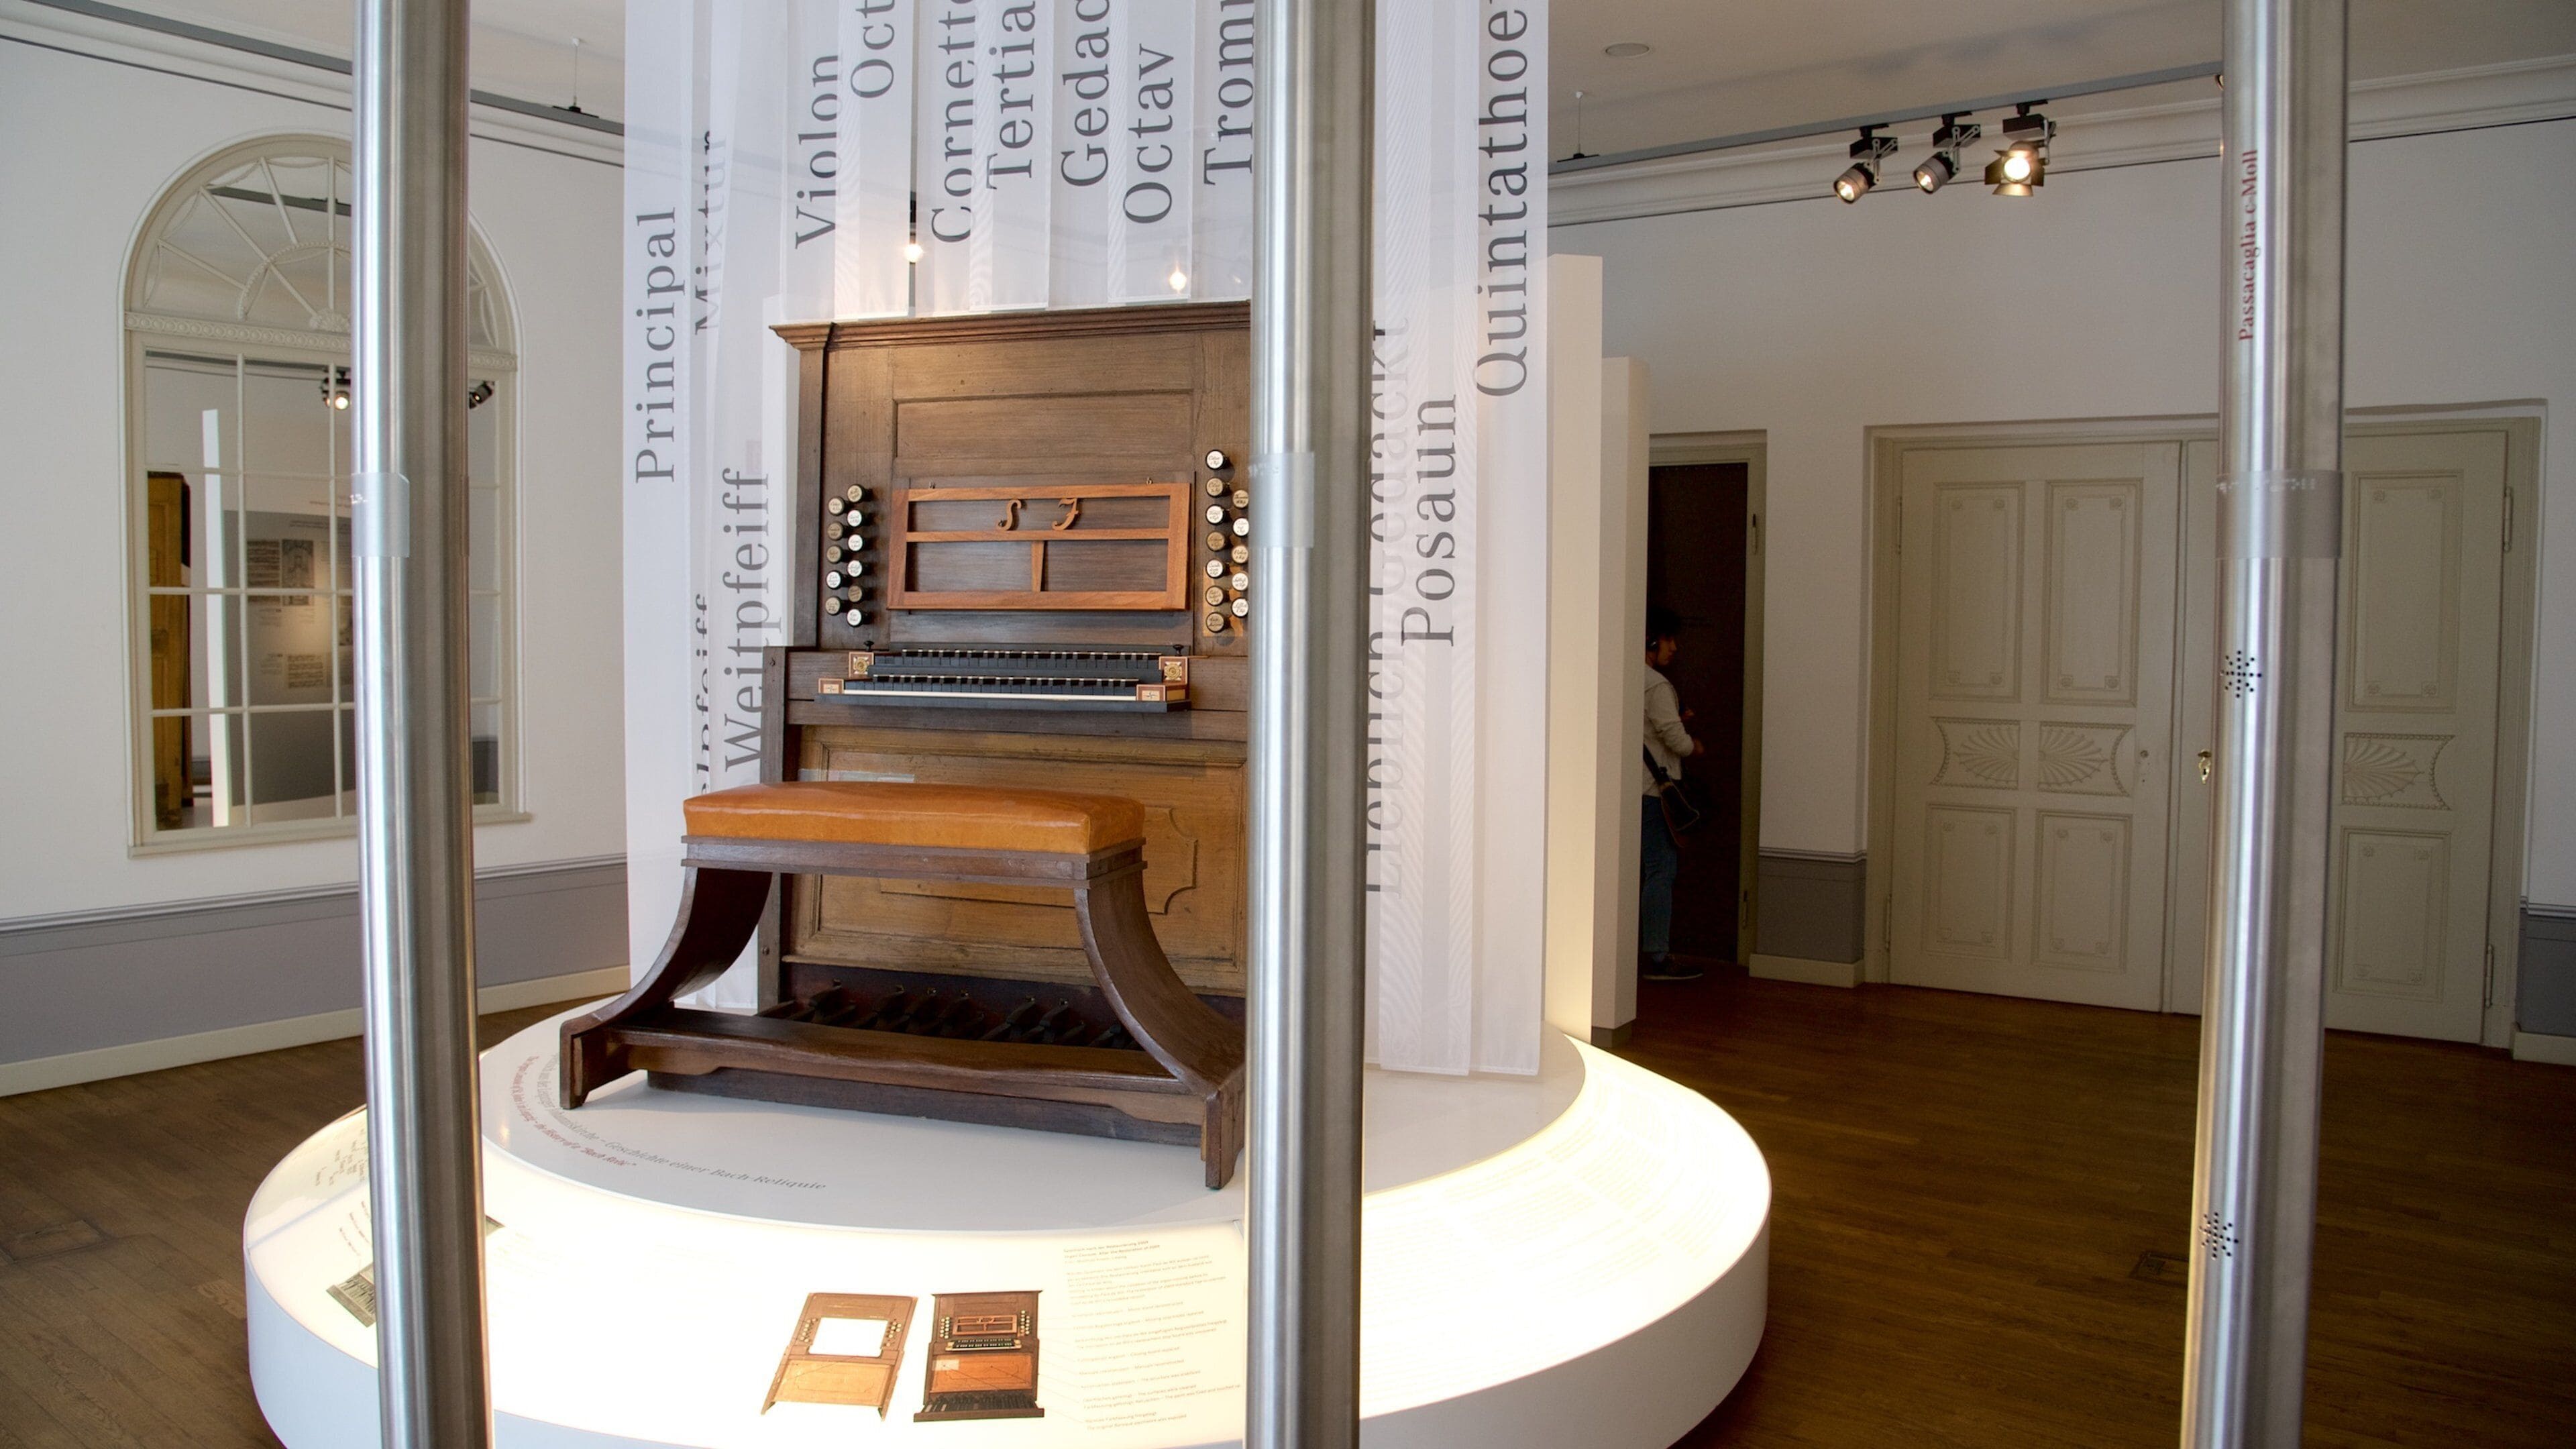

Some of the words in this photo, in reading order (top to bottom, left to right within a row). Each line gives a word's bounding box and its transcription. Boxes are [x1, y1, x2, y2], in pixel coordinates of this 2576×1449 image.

[795, 54, 839, 250] Violon
[931, 0, 976, 243] Cornett
[985, 0, 1036, 190] Tertia
[1123, 43, 1175, 224] Octav
[1203, 0, 1254, 186] Trom
[1472, 0, 1528, 396] Quintathoe
[636, 207, 686, 484] Principal
[2239, 221, 2261, 341] Passacaglia
[722, 467, 782, 773] Weitpfeiff
[1399, 394, 1457, 647] Posaun
